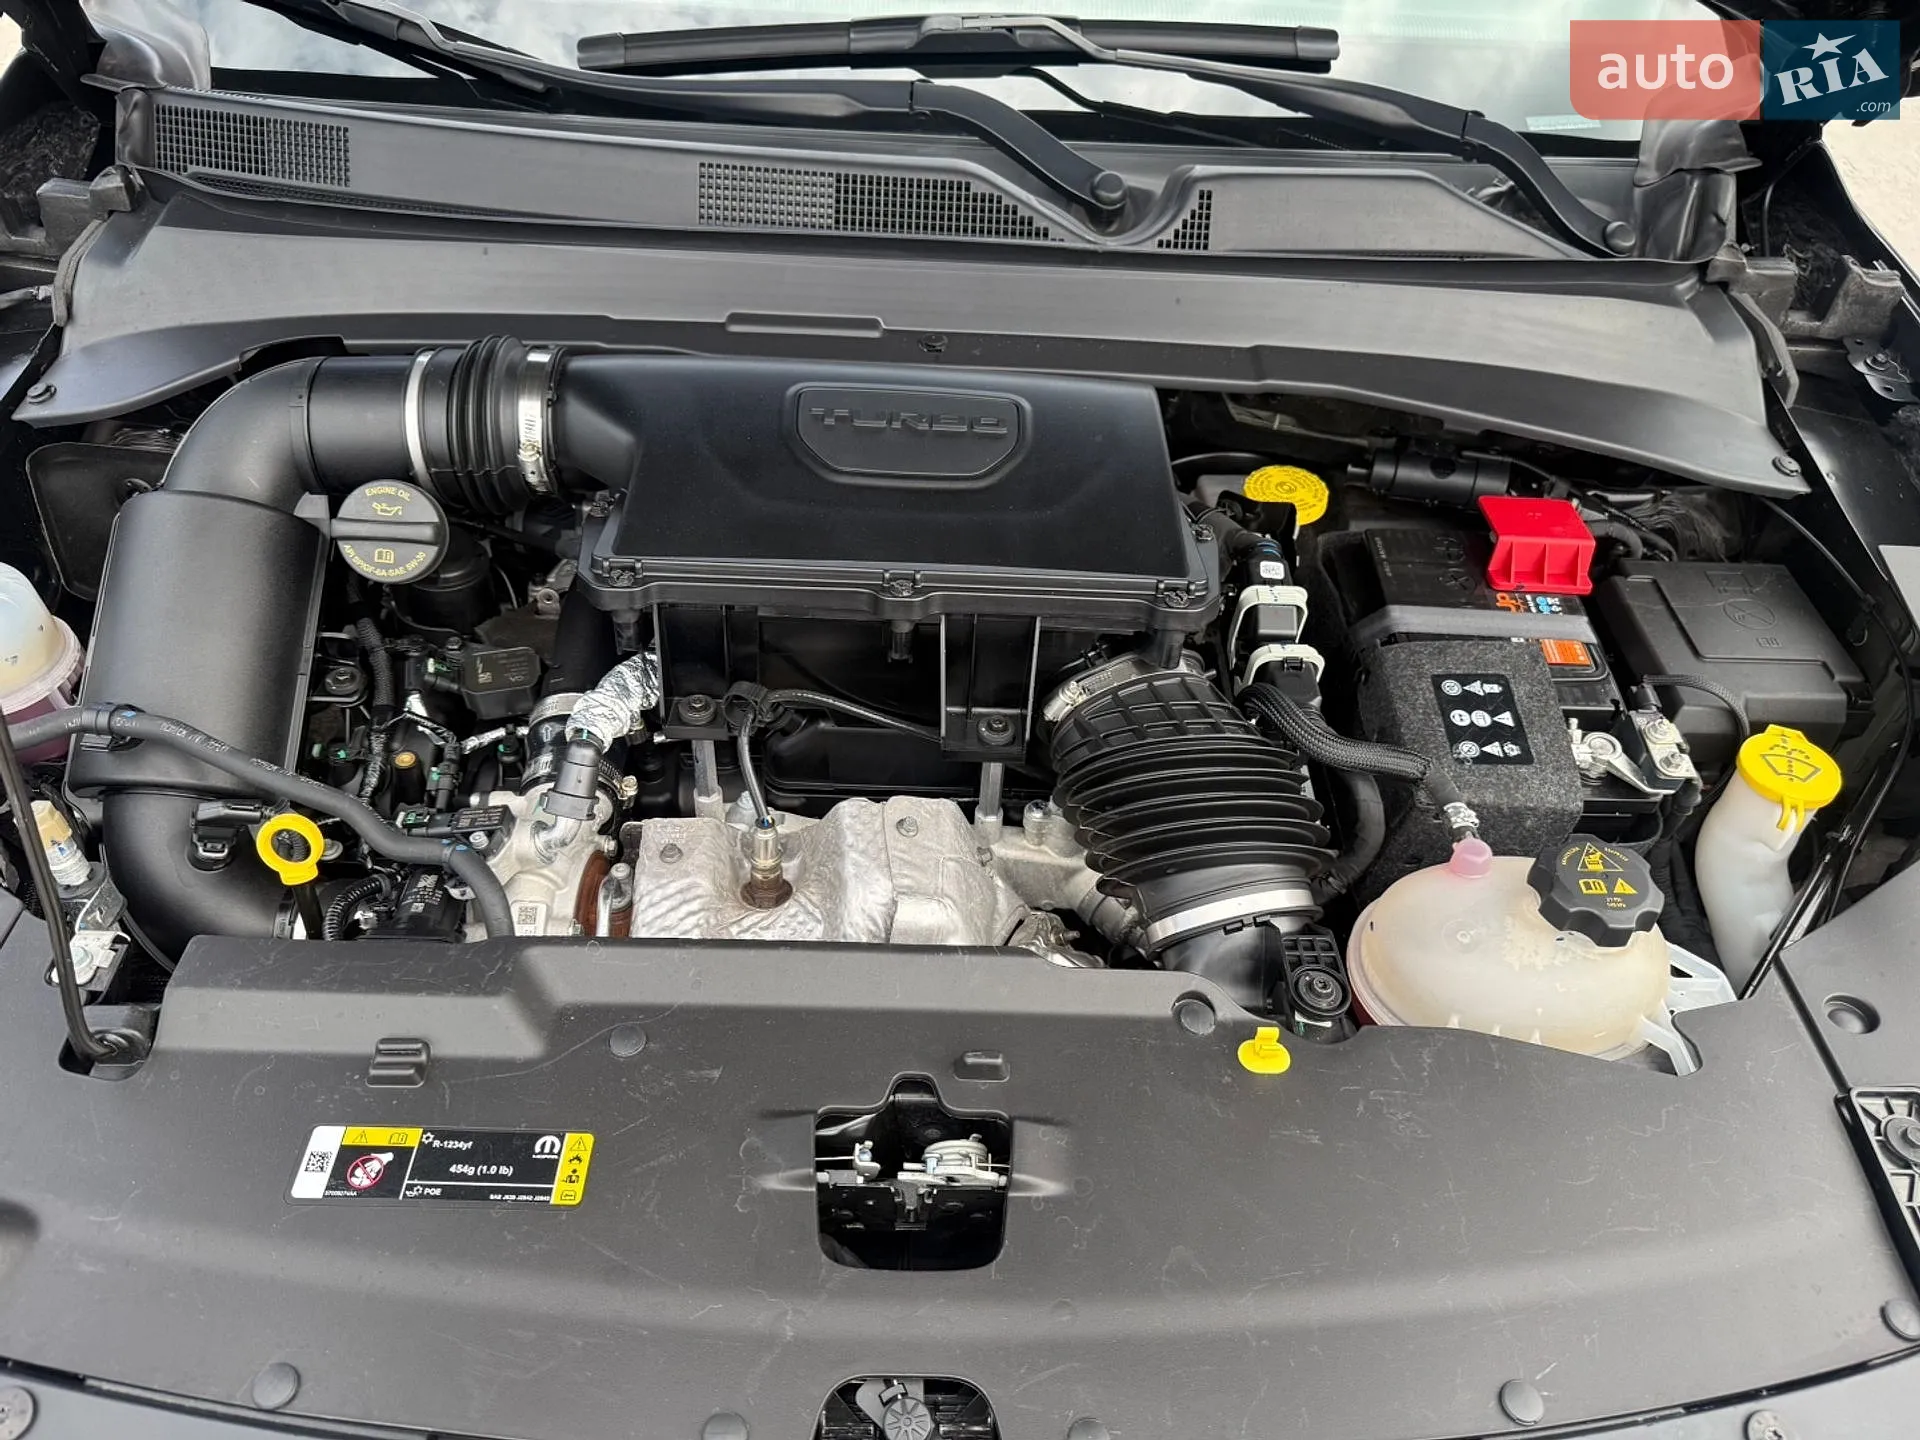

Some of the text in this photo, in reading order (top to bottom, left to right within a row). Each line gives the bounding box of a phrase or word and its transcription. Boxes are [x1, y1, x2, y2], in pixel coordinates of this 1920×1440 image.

[809, 407, 1008, 434] TURBO
[365, 486, 411, 501] ENGINE OIL
[432, 1140, 473, 1150] R-1234yf
[449, 1164, 513, 1176] 454g (1.0 lb)
[423, 1188, 442, 1196] POE
